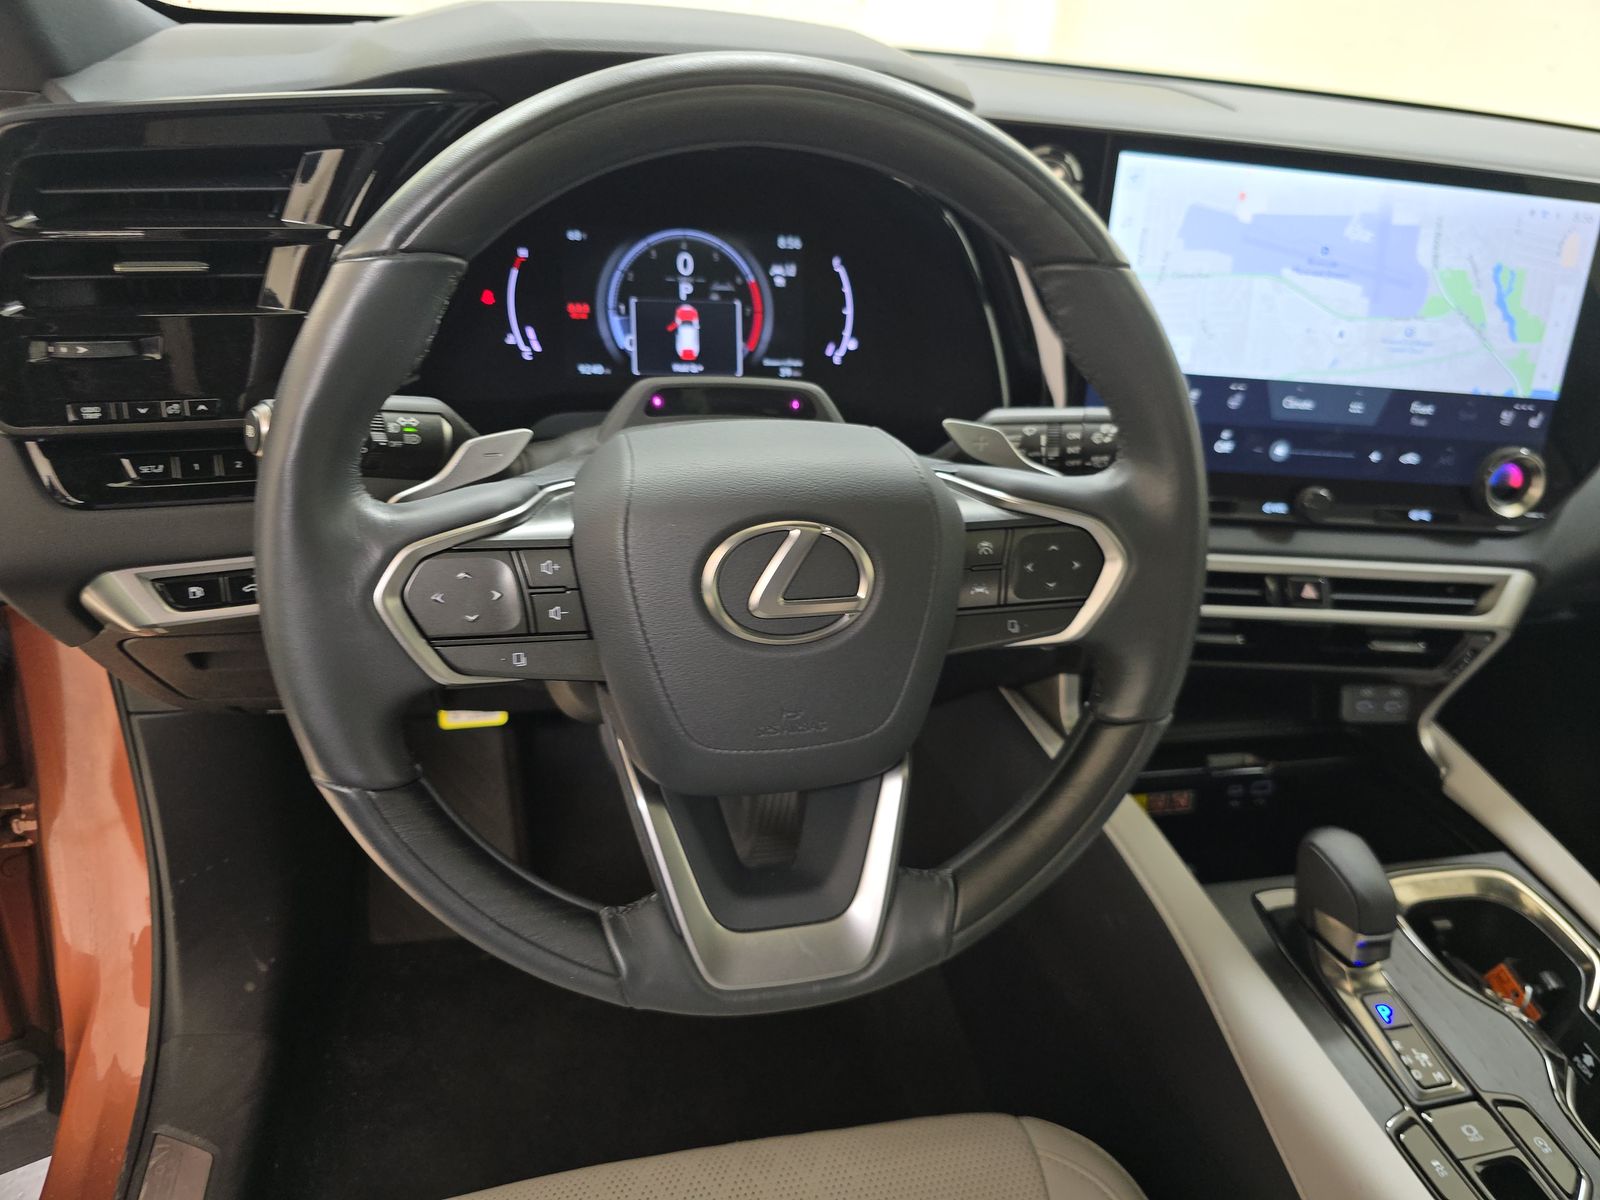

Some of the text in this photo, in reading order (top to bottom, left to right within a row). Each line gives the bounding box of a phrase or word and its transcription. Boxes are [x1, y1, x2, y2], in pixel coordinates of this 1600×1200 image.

[675, 250, 695, 277] 0
[678, 281, 694, 301] P
[1066, 431, 1081, 440] ON
[1374, 1003, 1393, 1025] P
